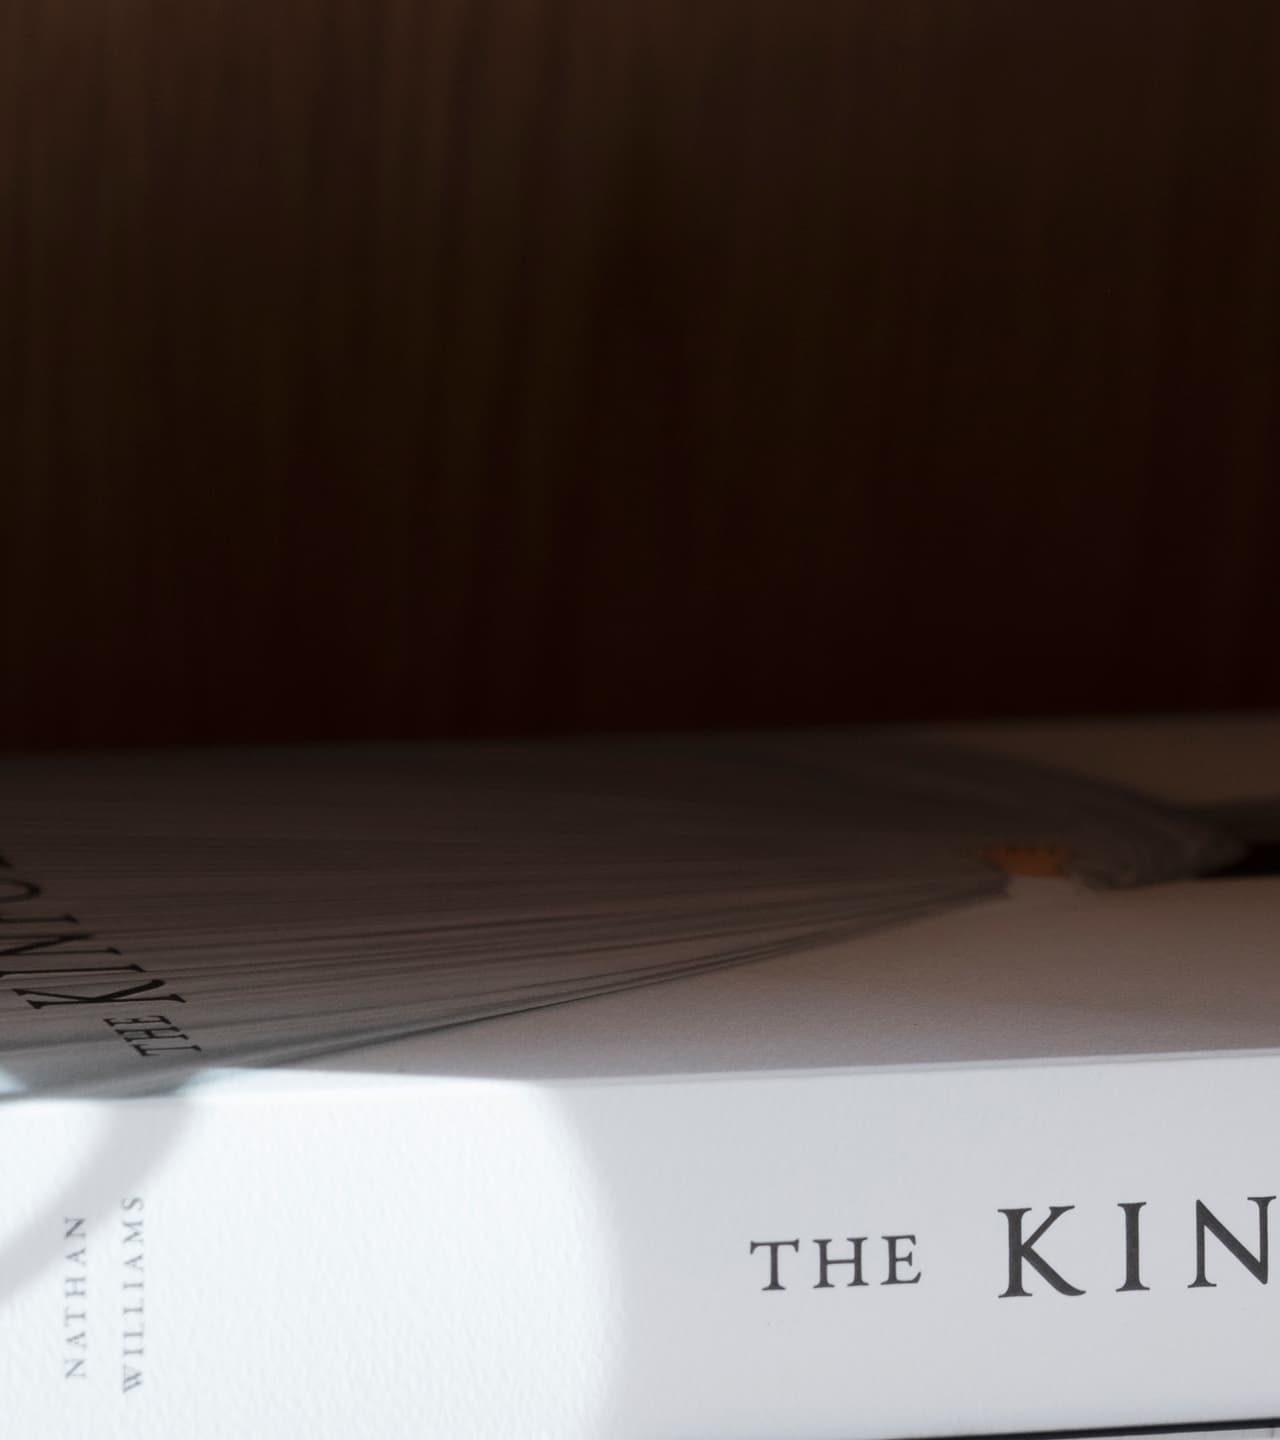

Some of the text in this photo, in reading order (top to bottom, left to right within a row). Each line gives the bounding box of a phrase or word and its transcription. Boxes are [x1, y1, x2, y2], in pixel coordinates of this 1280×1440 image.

[103, 1016, 202, 1056] THE
[63, 1217, 87, 1379] NATHAN
[121, 1195, 145, 1394] WILLIAMS
[749, 1234, 922, 1292] THE
